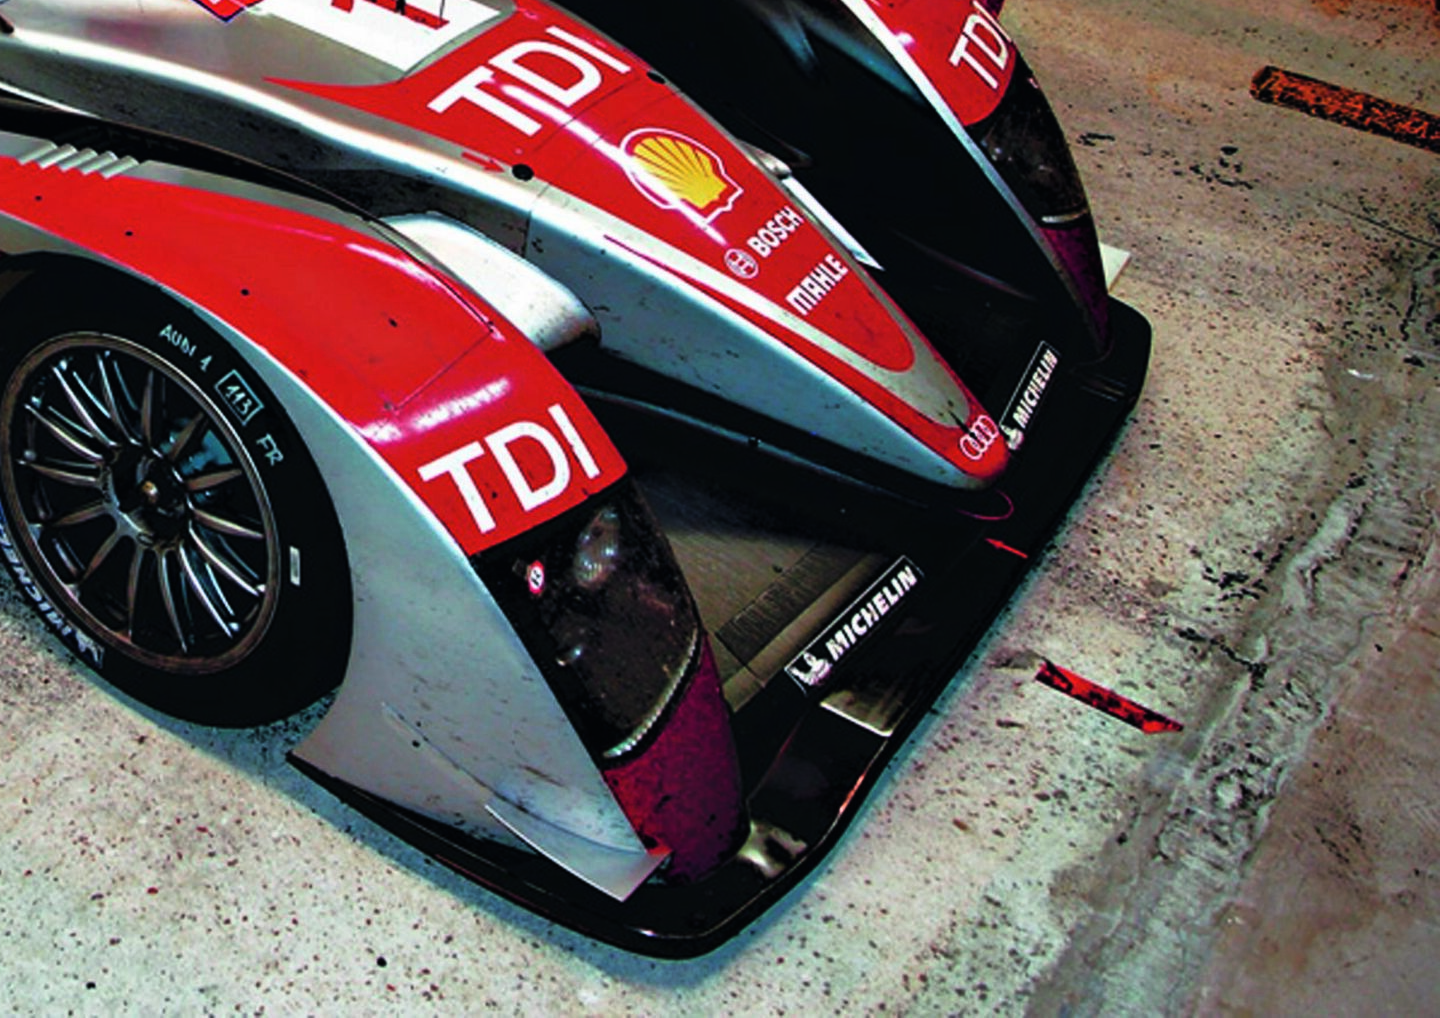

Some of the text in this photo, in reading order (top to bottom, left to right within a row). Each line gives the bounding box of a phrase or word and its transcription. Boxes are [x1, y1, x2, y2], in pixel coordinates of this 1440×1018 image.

[427, 25, 631, 137] TDI
[948, 0, 1013, 90] TDI
[747, 205, 805, 258] BOSCH
[785, 254, 849, 316] MAHLE
[159, 324, 198, 357] AUDI
[225, 384, 253, 416] 113
[256, 433, 284, 467] FR
[1013, 349, 1058, 429] MICHELIN
[418, 403, 601, 536] TDI
[824, 565, 917, 662] MICHELIN
